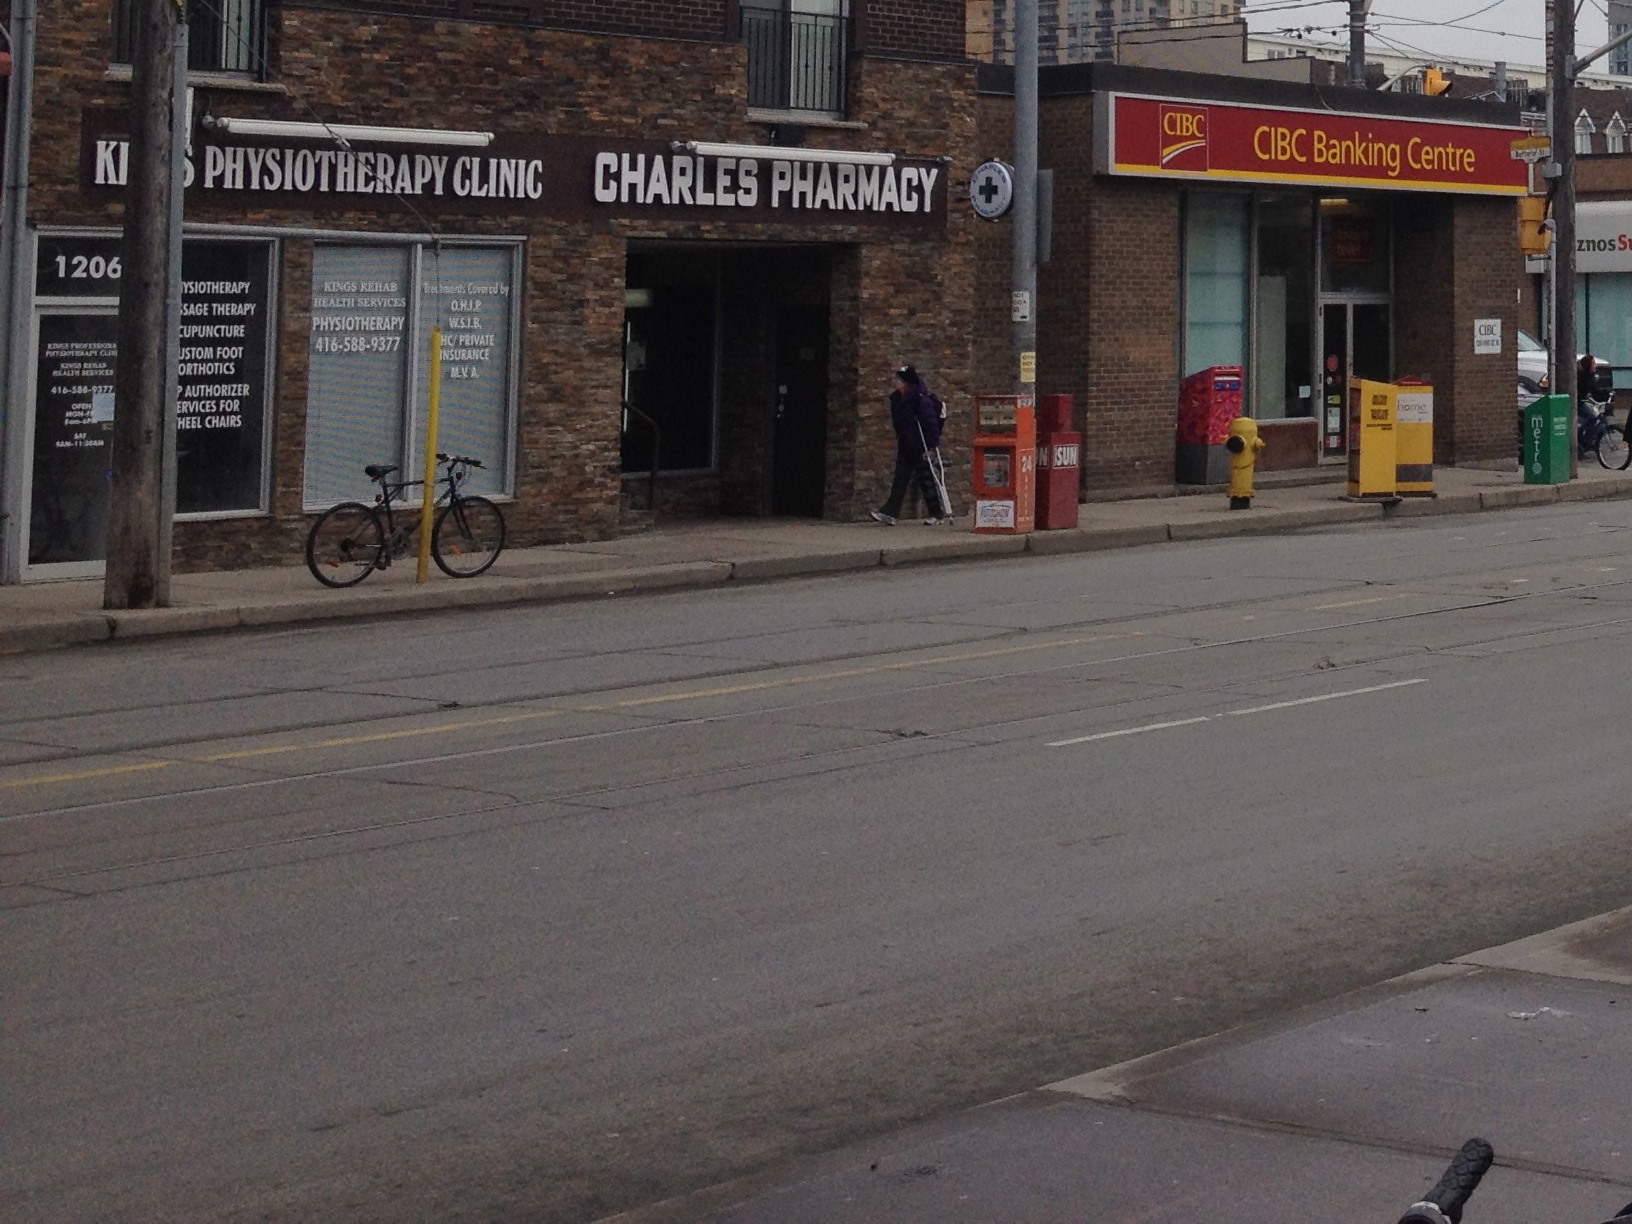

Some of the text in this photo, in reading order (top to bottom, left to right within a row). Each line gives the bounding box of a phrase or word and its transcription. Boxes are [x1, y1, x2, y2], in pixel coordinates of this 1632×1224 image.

[1163, 112, 1205, 137] CIBC
[1254, 126, 1476, 176] CIBC Banking Centre
[95, 140, 543, 199] KIS PHYSIOTHERAPY CLINIC
[594, 152, 939, 213] CHARLES PHARMACY
[1577, 239, 1616, 252] znos
[55, 255, 122, 278] 1206
[182, 281, 250, 294] YSIOTHERAPY
[324, 282, 398, 292] KINGS REHAB
[314, 298, 406, 307] HEALTH SERVICES
[180, 303, 256, 316] SAGE THERAPY
[312, 317, 405, 331] PHYSIOTHERAPY
[179, 325, 245, 338] CUPUNCTURE
[315, 337, 400, 352] 416-588-9377
[459, 335, 494, 346] PRIVATE
[179, 347, 244, 360] USTOM FOOT
[440, 349, 490, 360] INSURANCE
[178, 362, 235, 375] ORTHOTICS
[185, 384, 250, 397] AUTHORIZER
[177, 400, 240, 413] ERVICES FOR
[177, 415, 242, 430] HEEL CHAIRS
[1056, 446, 1078, 466] SUN
[1021, 456, 1033, 473] 24
